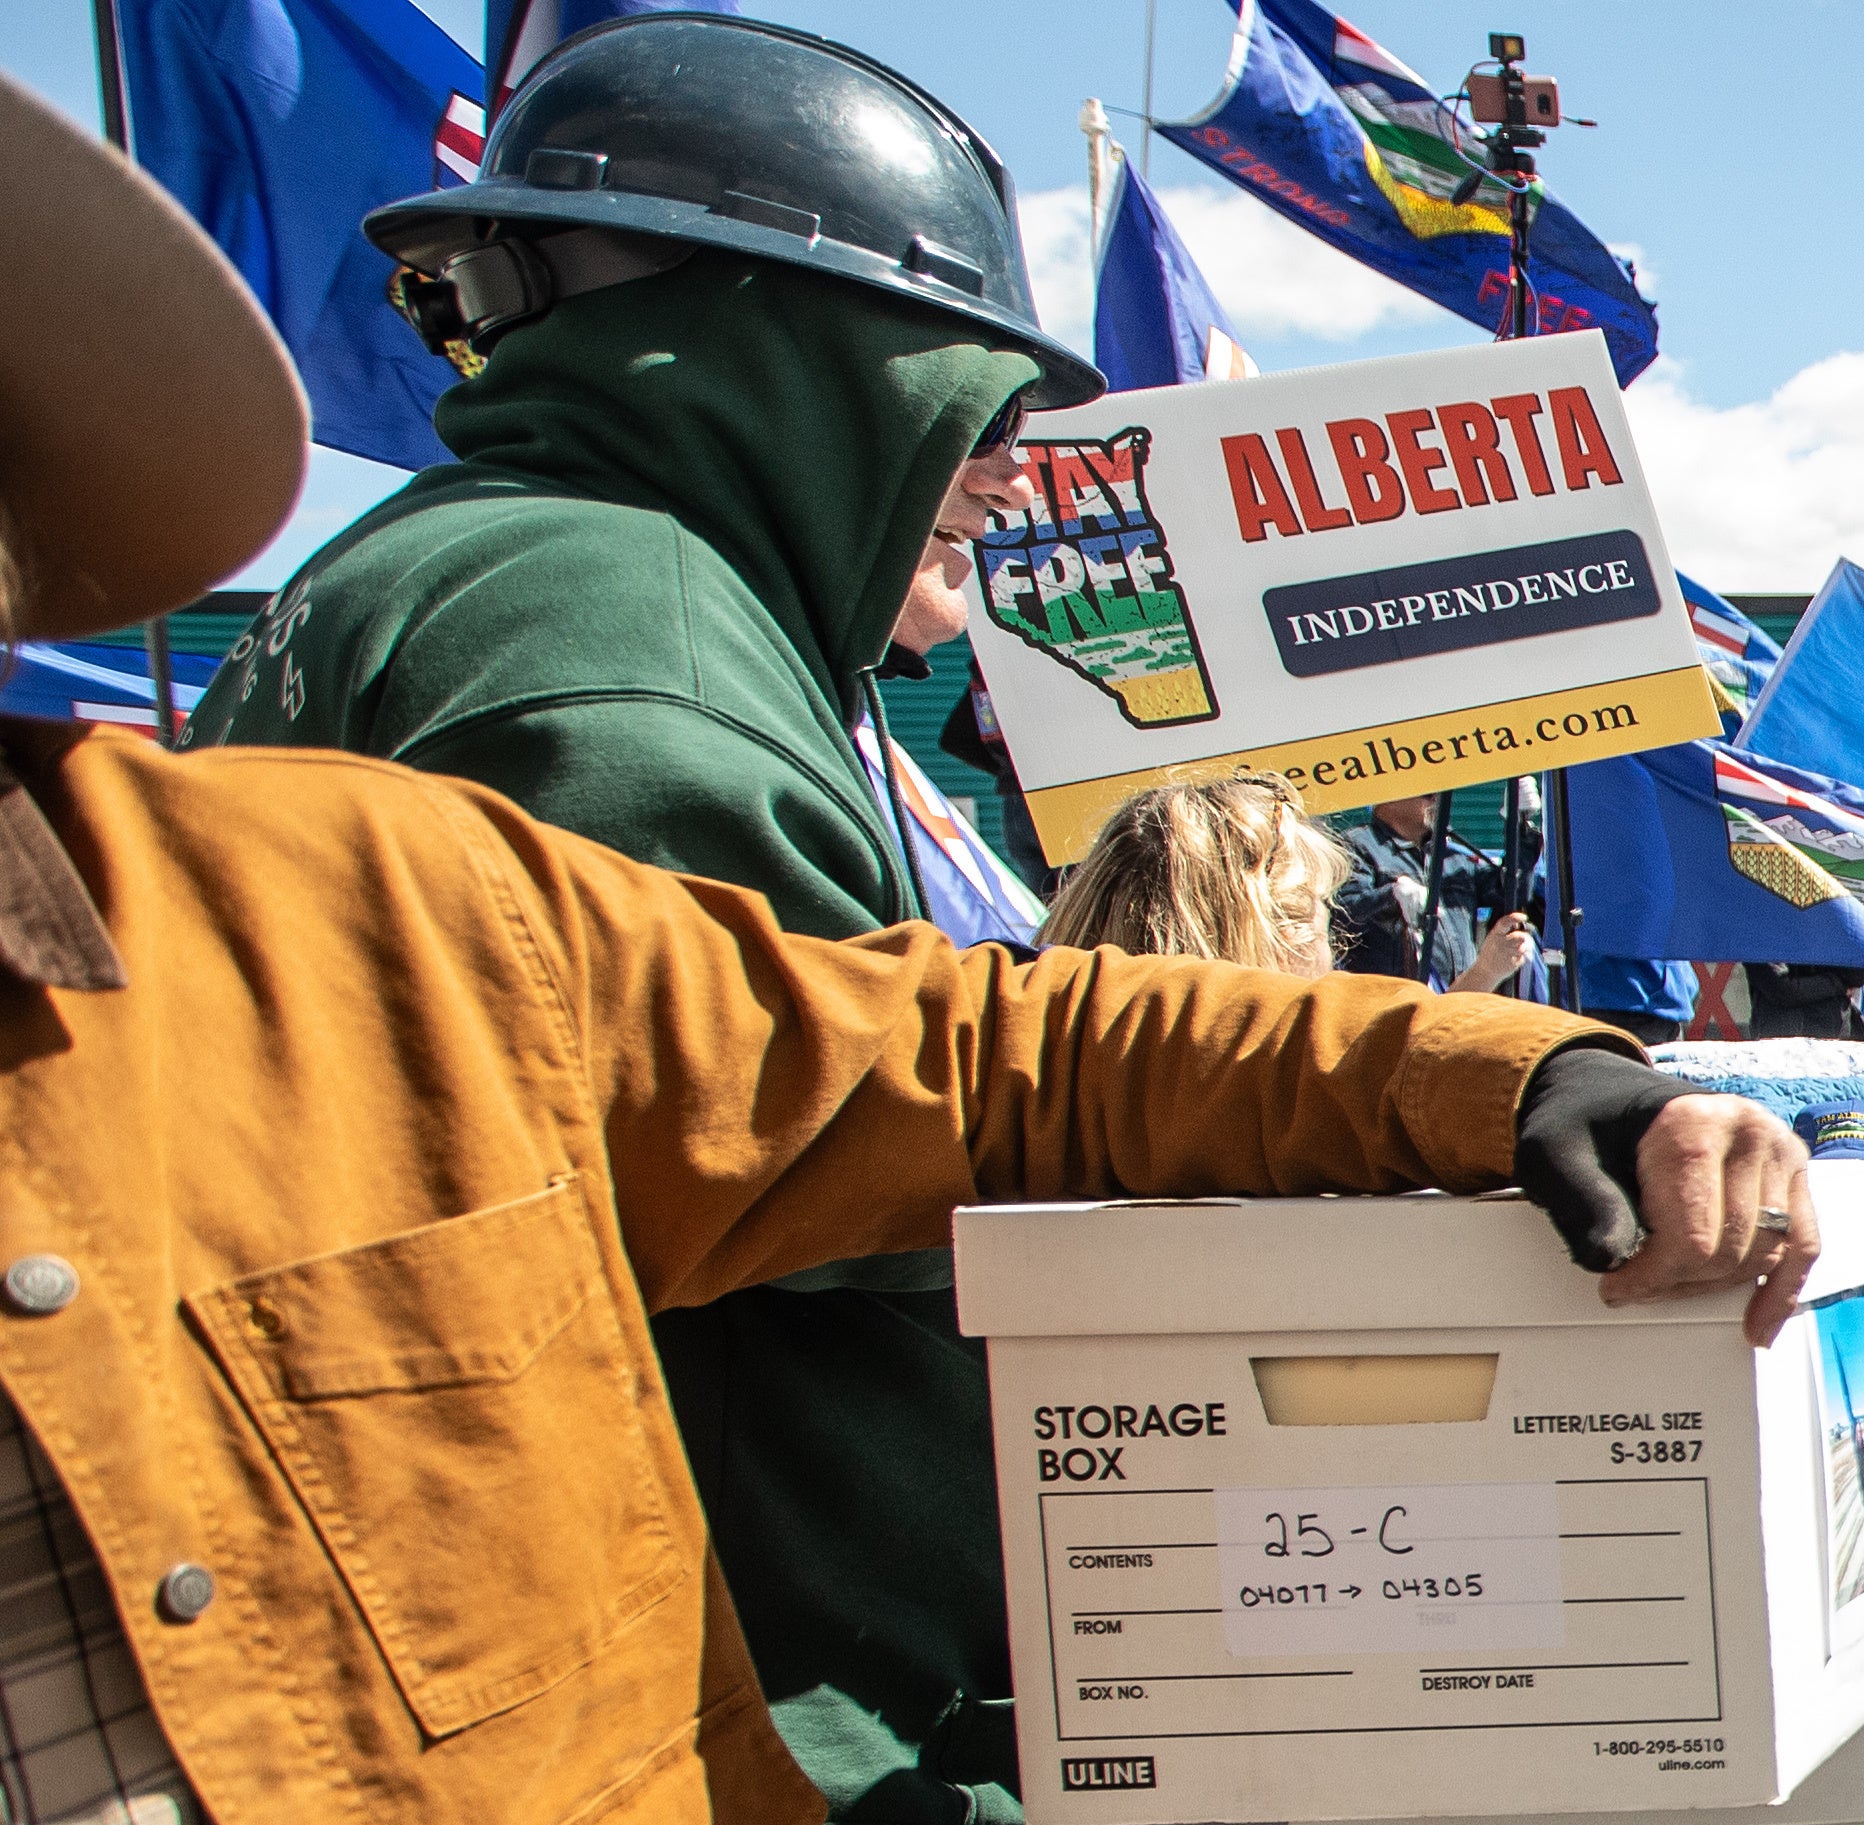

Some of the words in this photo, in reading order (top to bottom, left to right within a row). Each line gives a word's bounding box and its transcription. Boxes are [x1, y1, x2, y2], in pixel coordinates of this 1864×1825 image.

[1220, 385, 1624, 544] ALBERTA
[981, 528, 1187, 645] FREE
[1286, 559, 1636, 647] INDEPENDENCE
[1033, 1402, 1228, 1441] STORAGE
[1513, 1413, 1655, 1435] LETTER/LEGAL
[1660, 1411, 1703, 1432] SIZE
[1037, 1446, 1127, 1482] BOX
[1609, 1440, 1704, 1465] S-3887
[1068, 1553, 1154, 1570] CONTENTS
[1239, 1583, 1329, 1608] 04077
[1382, 1572, 1484, 1600] 04305
[1072, 1619, 1123, 1636] FROM
[1078, 1686, 1114, 1701] BOX
[1116, 1684, 1150, 1701] NO.
[1421, 1675, 1492, 1692] DESTROY
[1495, 1673, 1535, 1690] DATE
[1592, 1738, 1725, 1756] 1-800-295-5510
[1066, 1760, 1151, 1787] ULINE
[1657, 1757, 1726, 1772] uline.com
